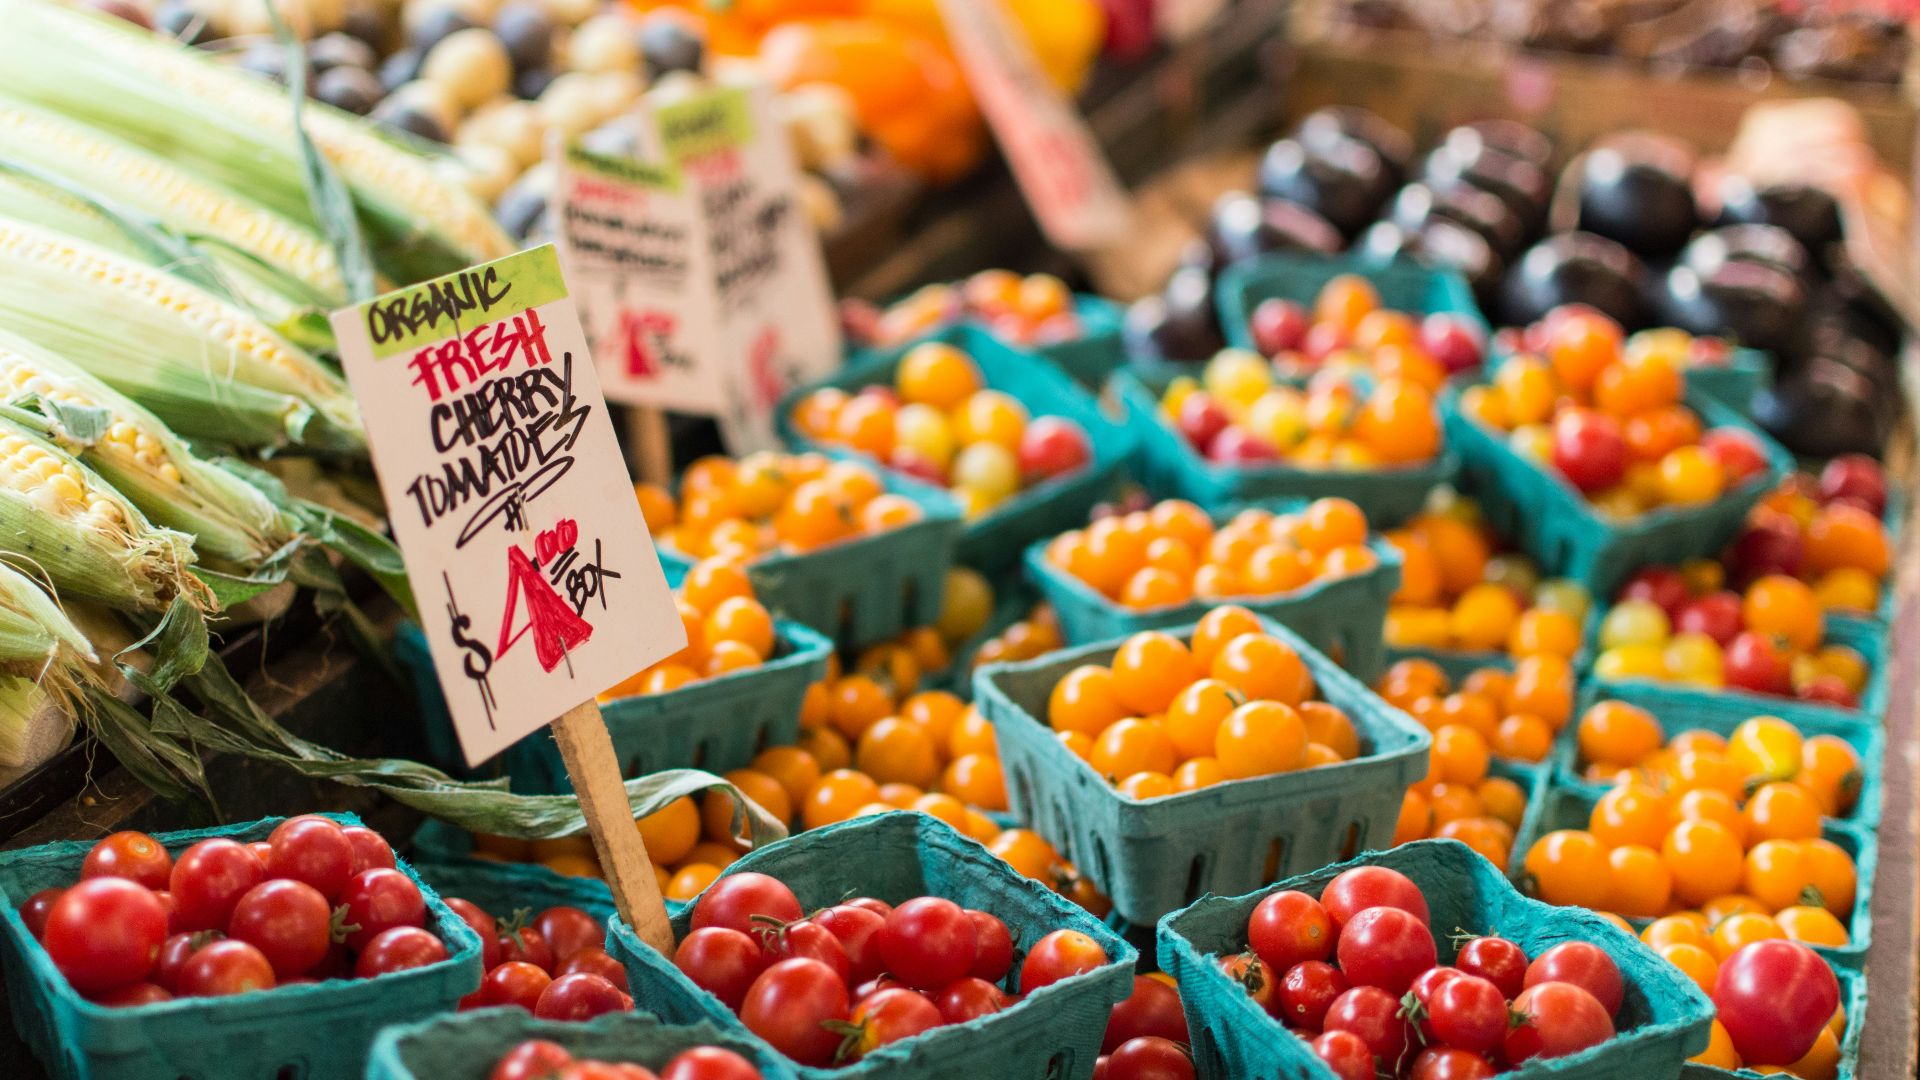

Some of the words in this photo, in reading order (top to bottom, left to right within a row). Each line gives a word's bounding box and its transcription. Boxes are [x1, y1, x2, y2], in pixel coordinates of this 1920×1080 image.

[368, 266, 512, 345] ORGANIC
[407, 307, 552, 402] FRESH
[430, 351, 573, 453] CHERRY
[406, 396, 592, 528] TOMATOES
[565, 538, 621, 618] BOX
